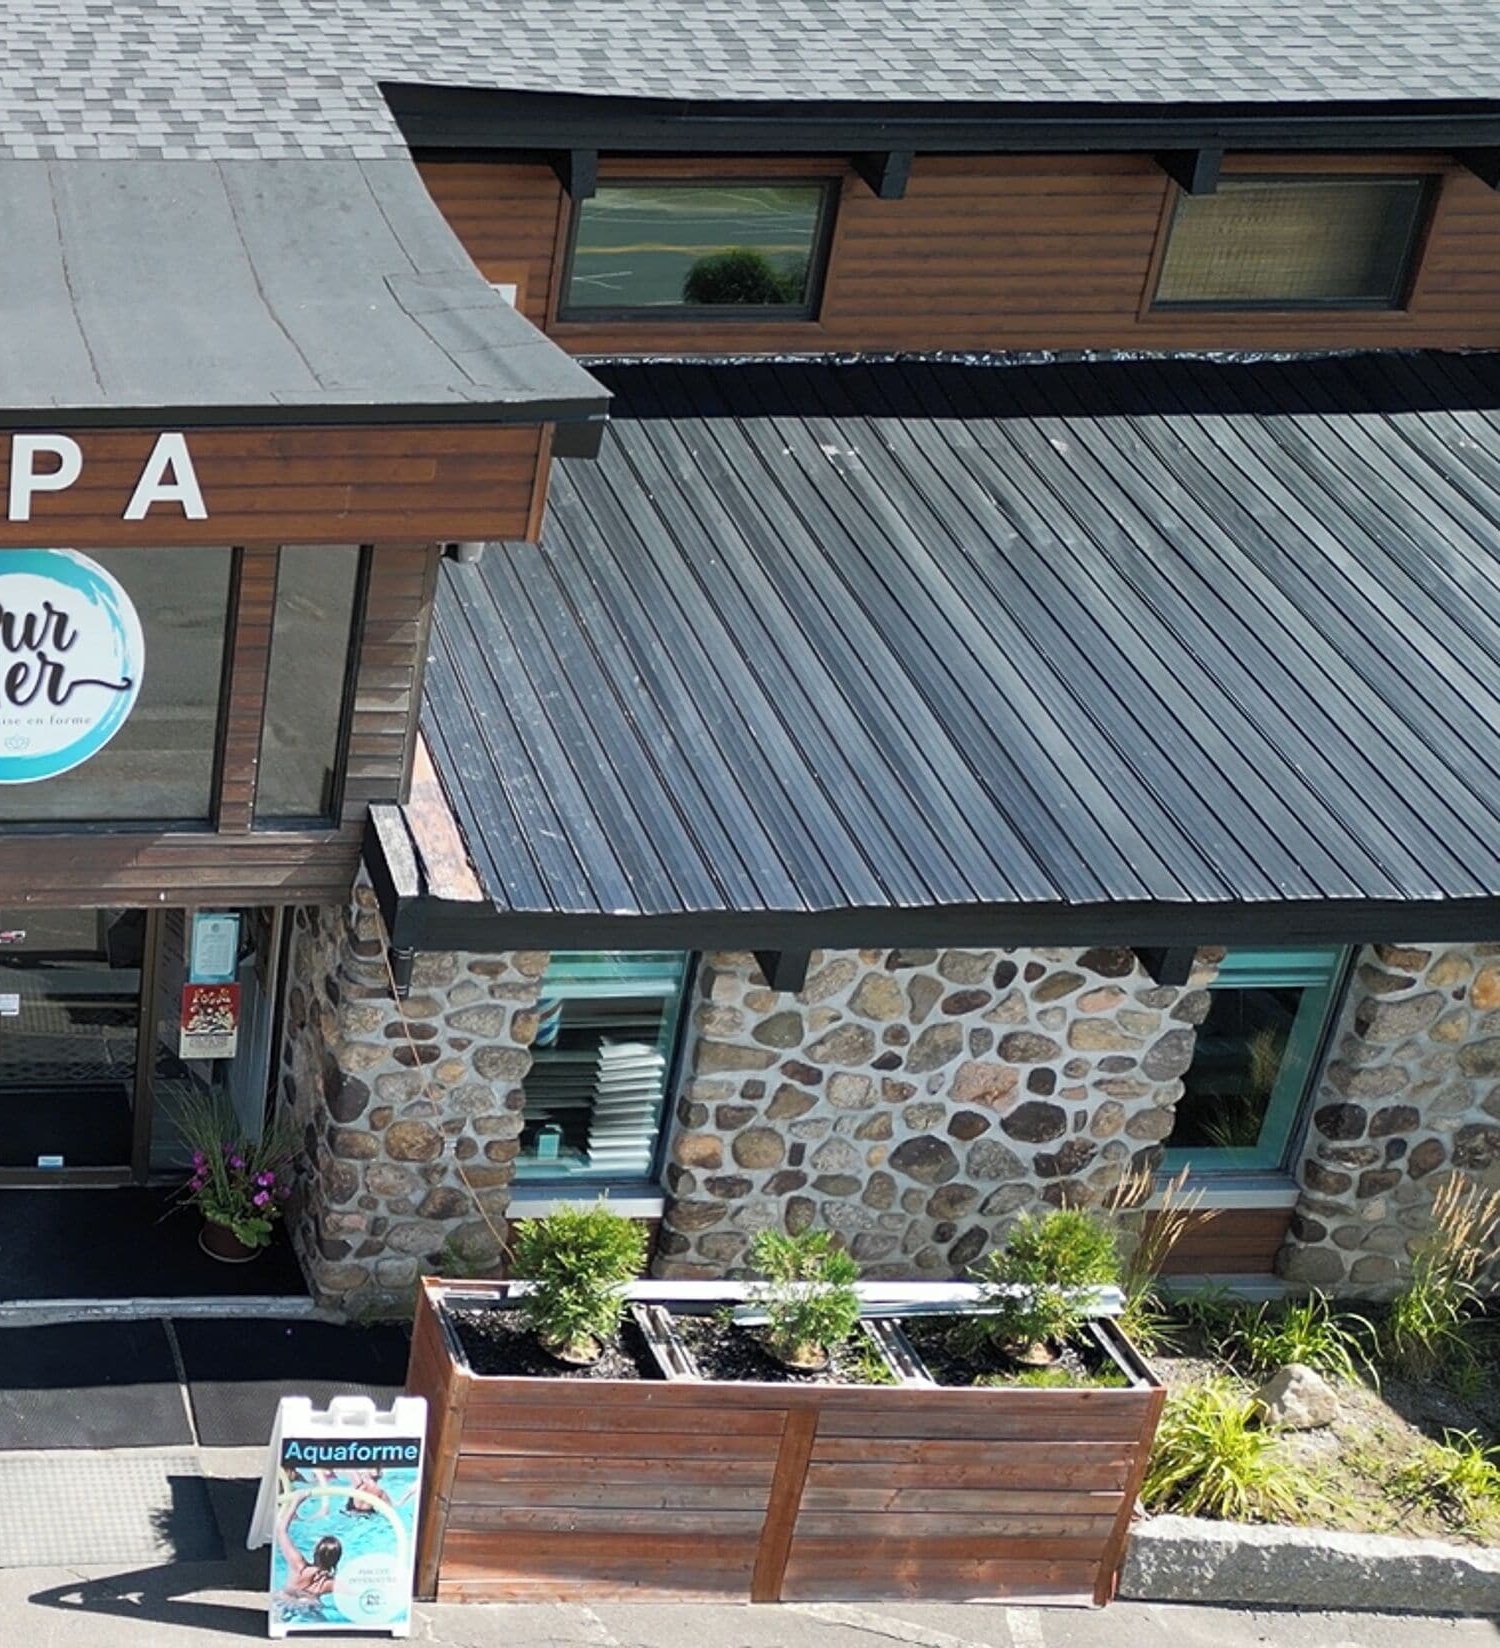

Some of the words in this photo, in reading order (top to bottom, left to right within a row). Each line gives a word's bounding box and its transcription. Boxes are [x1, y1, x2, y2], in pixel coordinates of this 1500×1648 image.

[27, 717, 44, 726] en
[49, 714, 92, 726] forme
[285, 1441, 418, 1465] Aquaforme
